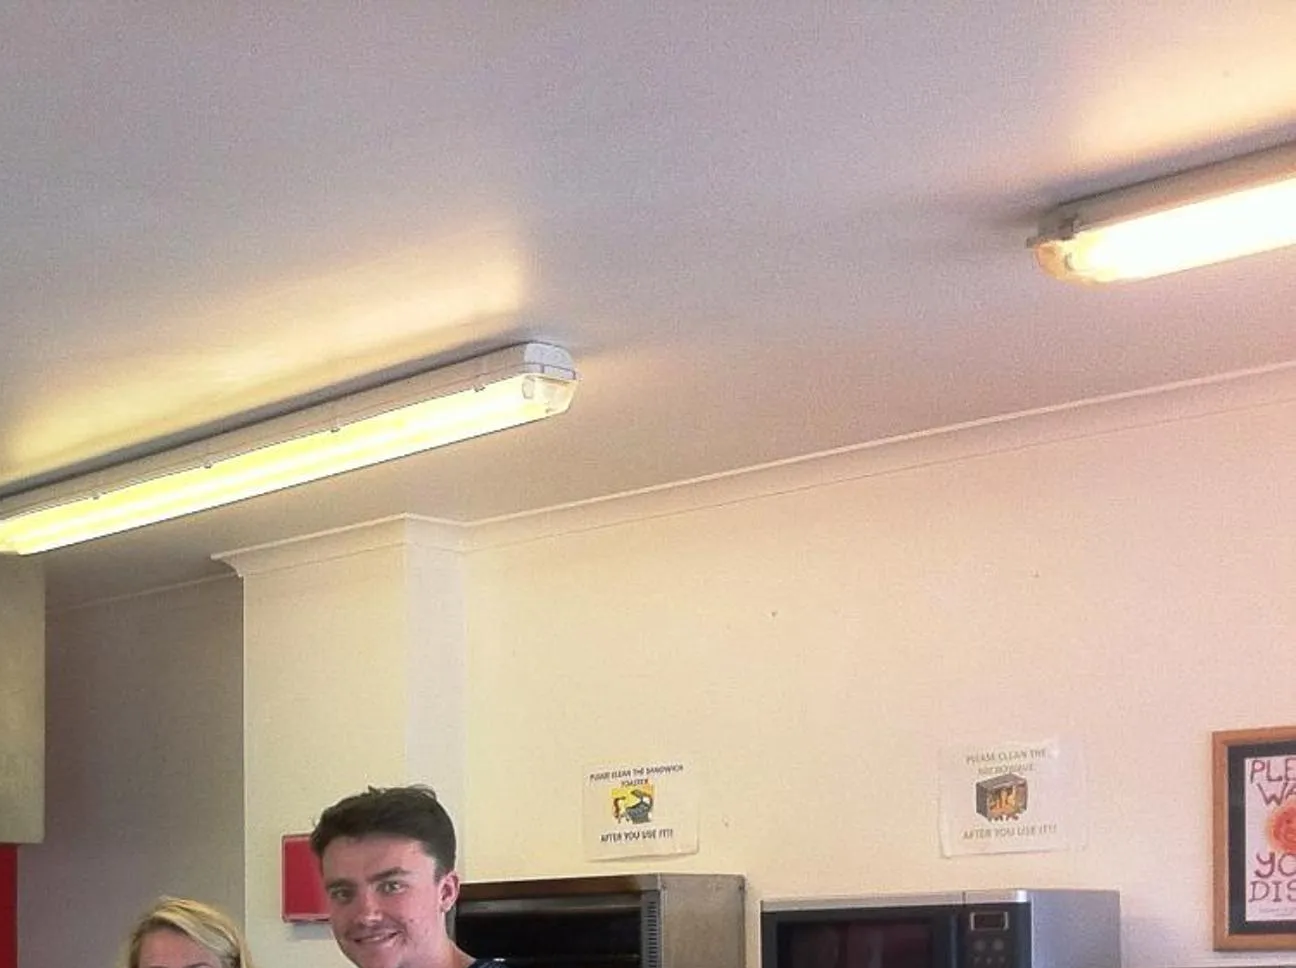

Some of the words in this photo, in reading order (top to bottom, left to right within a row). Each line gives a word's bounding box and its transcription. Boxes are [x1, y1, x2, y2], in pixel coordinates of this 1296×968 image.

[998, 749, 1026, 761] CLEAN
[1029, 748, 1046, 759] THE
[611, 769, 632, 780] CLEAN
[632, 766, 645, 776] THE
[646, 763, 684, 776] SANDWICH
[600, 831, 622, 843] AFTER
[623, 830, 640, 841] YOU
[641, 829, 657, 840] USE
[963, 827, 992, 840] AFTER
[995, 826, 1015, 837] YOU
[1017, 825, 1036, 836] USE
[1248, 880, 1296, 902] DIS
